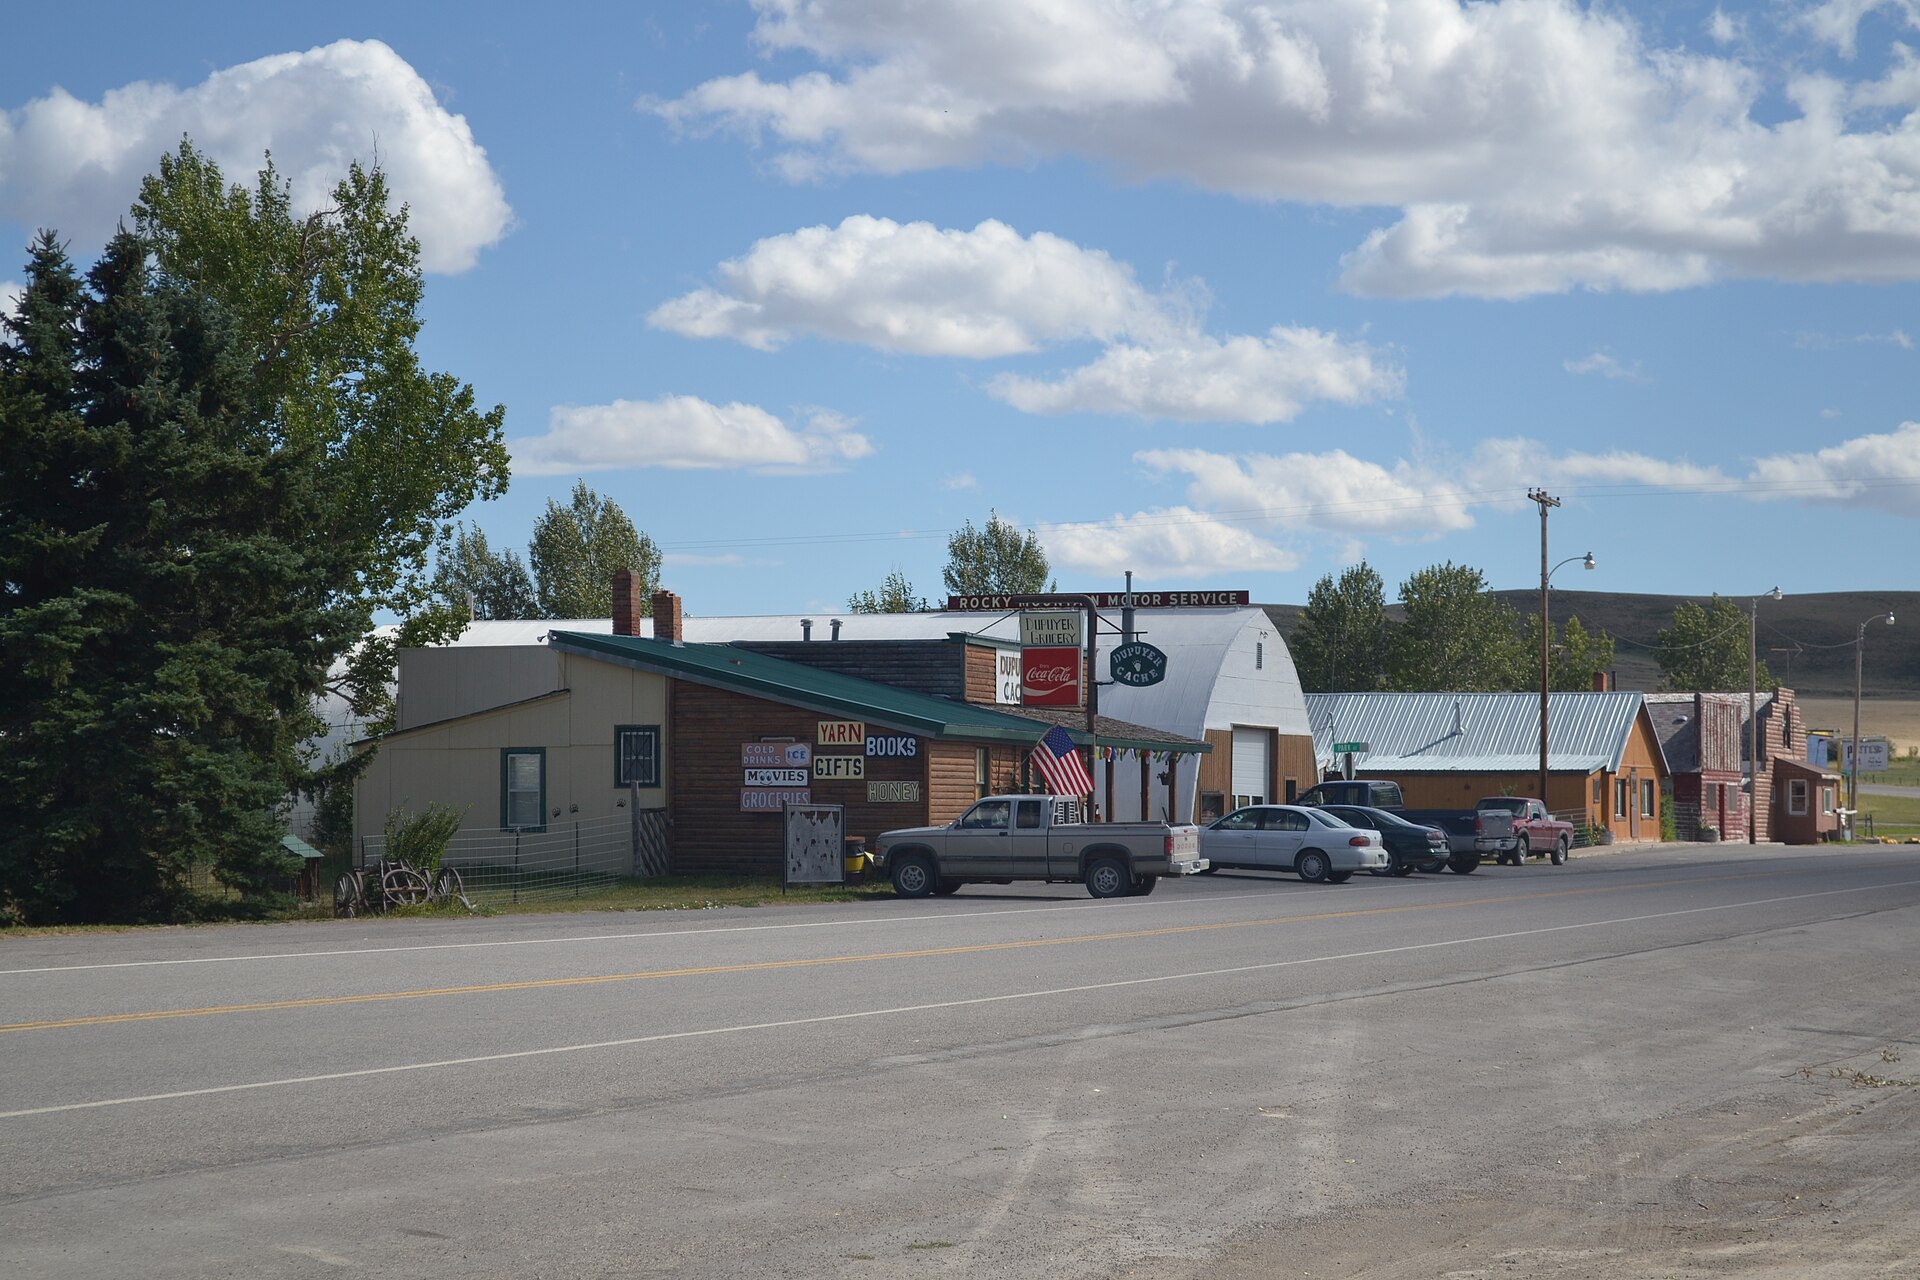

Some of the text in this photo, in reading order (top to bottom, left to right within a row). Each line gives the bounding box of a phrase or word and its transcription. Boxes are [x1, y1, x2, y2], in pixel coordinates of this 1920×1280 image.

[959, 596, 1012, 609] ROCKY
[1108, 594, 1161, 606] MOTOR
[1169, 592, 1237, 605] SERVICE
[1025, 617, 1075, 631] DUPUYER
[1030, 631, 1076, 645] GROCERY
[1112, 645, 1162, 667] DUPUYER
[1000, 655, 1021, 677] DUPU
[1025, 665, 1073, 682] Coca-Cola
[1116, 666, 1158, 683] CACHE
[1003, 681, 1021, 701] CAC
[820, 723, 862, 743] YARN
[746, 745, 775, 754] COLD
[787, 750, 807, 759] ICE
[866, 736, 917, 757] BOOKS
[743, 755, 781, 765] DRINKS
[815, 758, 862, 776] GIFTS
[742, 791, 809, 808] GROCERIES
[868, 782, 919, 801] HONEY
